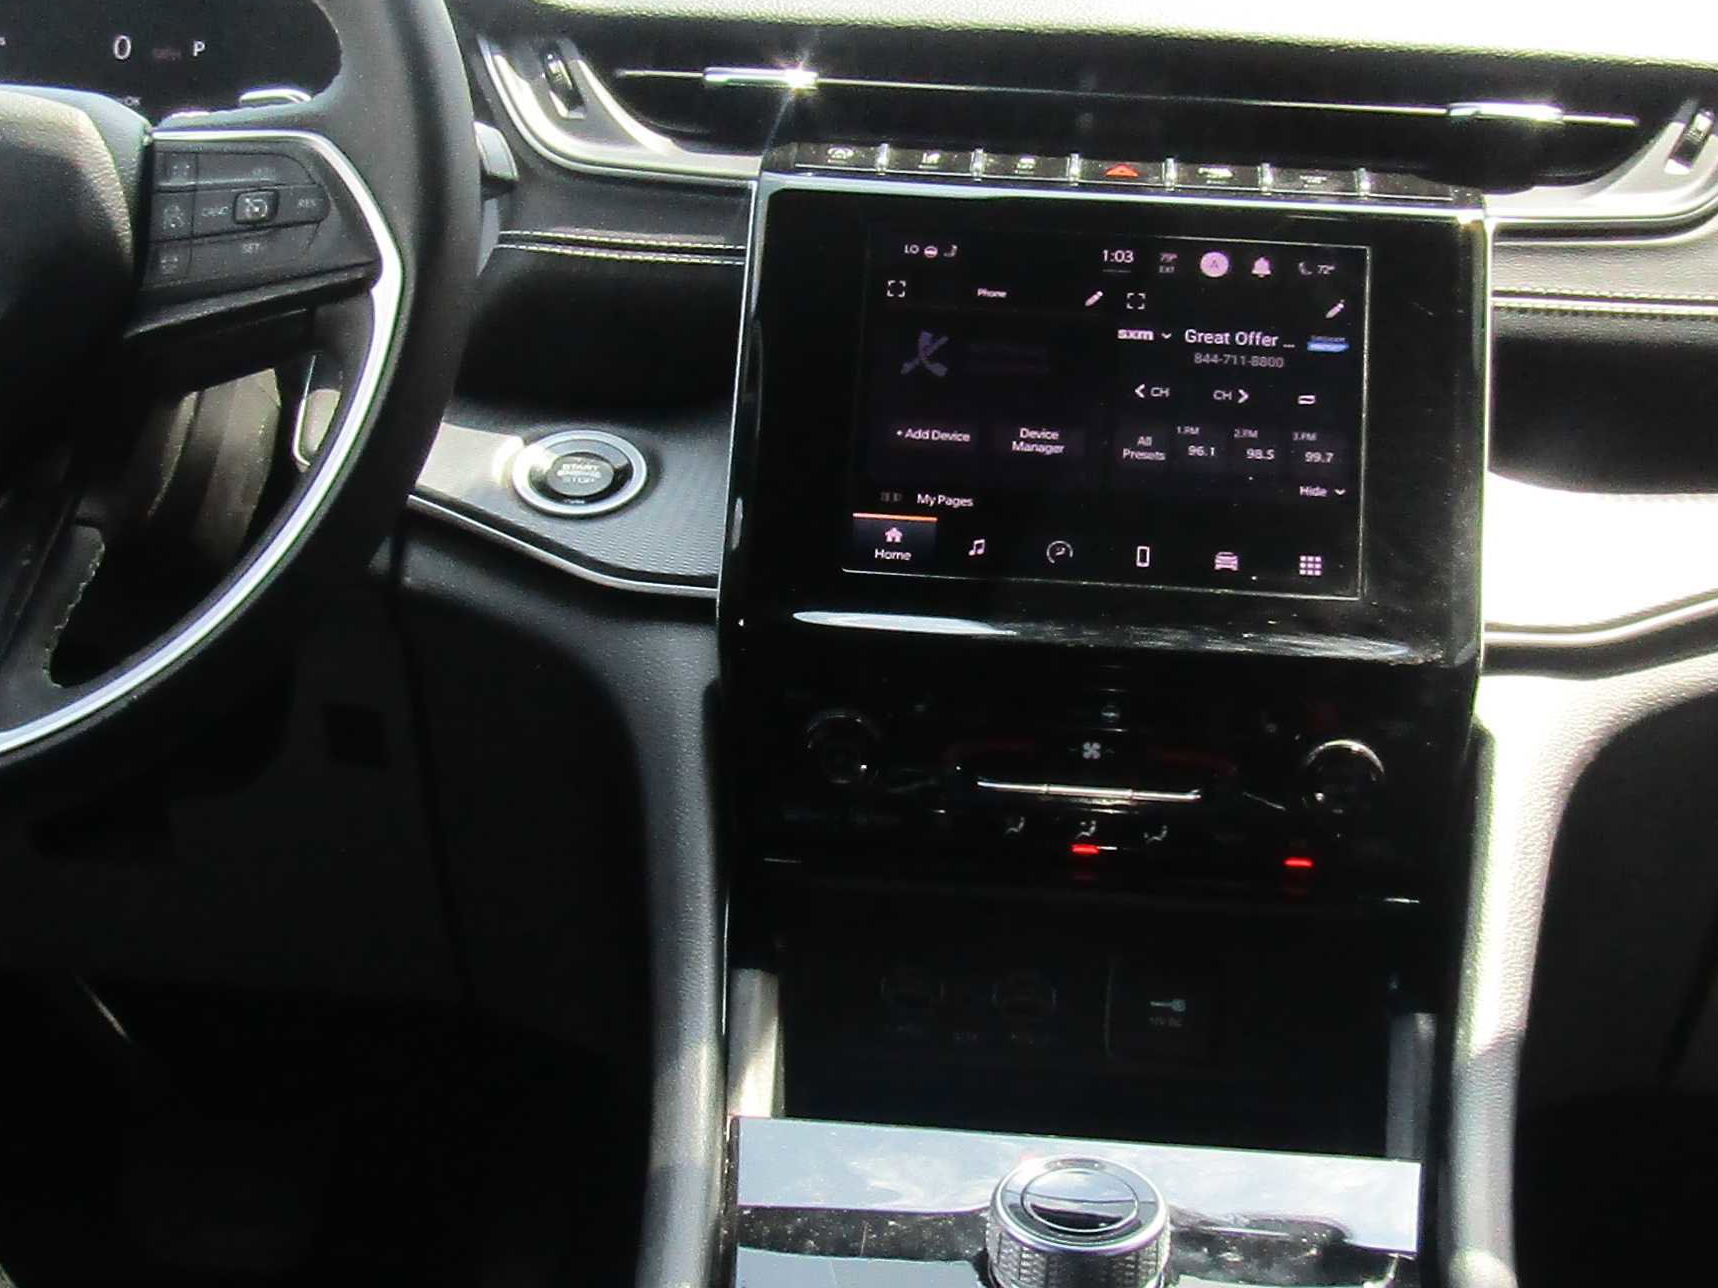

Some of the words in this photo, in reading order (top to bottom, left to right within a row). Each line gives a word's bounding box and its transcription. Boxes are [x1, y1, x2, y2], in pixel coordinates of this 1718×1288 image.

[113, 34, 133, 61] 0
[191, 40, 205, 58] P
[904, 244, 920, 254] LO
[1102, 249, 1133, 263] 1:03
[977, 287, 1007, 299] Phone
[1118, 329, 1154, 341] sxm
[1184, 328, 1231, 346] Great
[1235, 330, 1279, 348] Offer
[1150, 387, 1170, 398] CH
[1213, 390, 1232, 401] CH
[904, 428, 930, 440] Add
[932, 429, 971, 442] Device
[1019, 427, 1060, 440] Device
[1137, 436, 1153, 447] All
[1012, 441, 1065, 456] Manager
[1122, 448, 1166, 462] Presets
[1188, 444, 1215, 457] 96.1
[1246, 448, 1275, 461] 98.5
[1305, 451, 1334, 464] 99.7
[1299, 485, 1327, 497] Hide
[917, 493, 935, 507] My
[937, 494, 973, 509] Pages
[874, 548, 912, 561] Home
